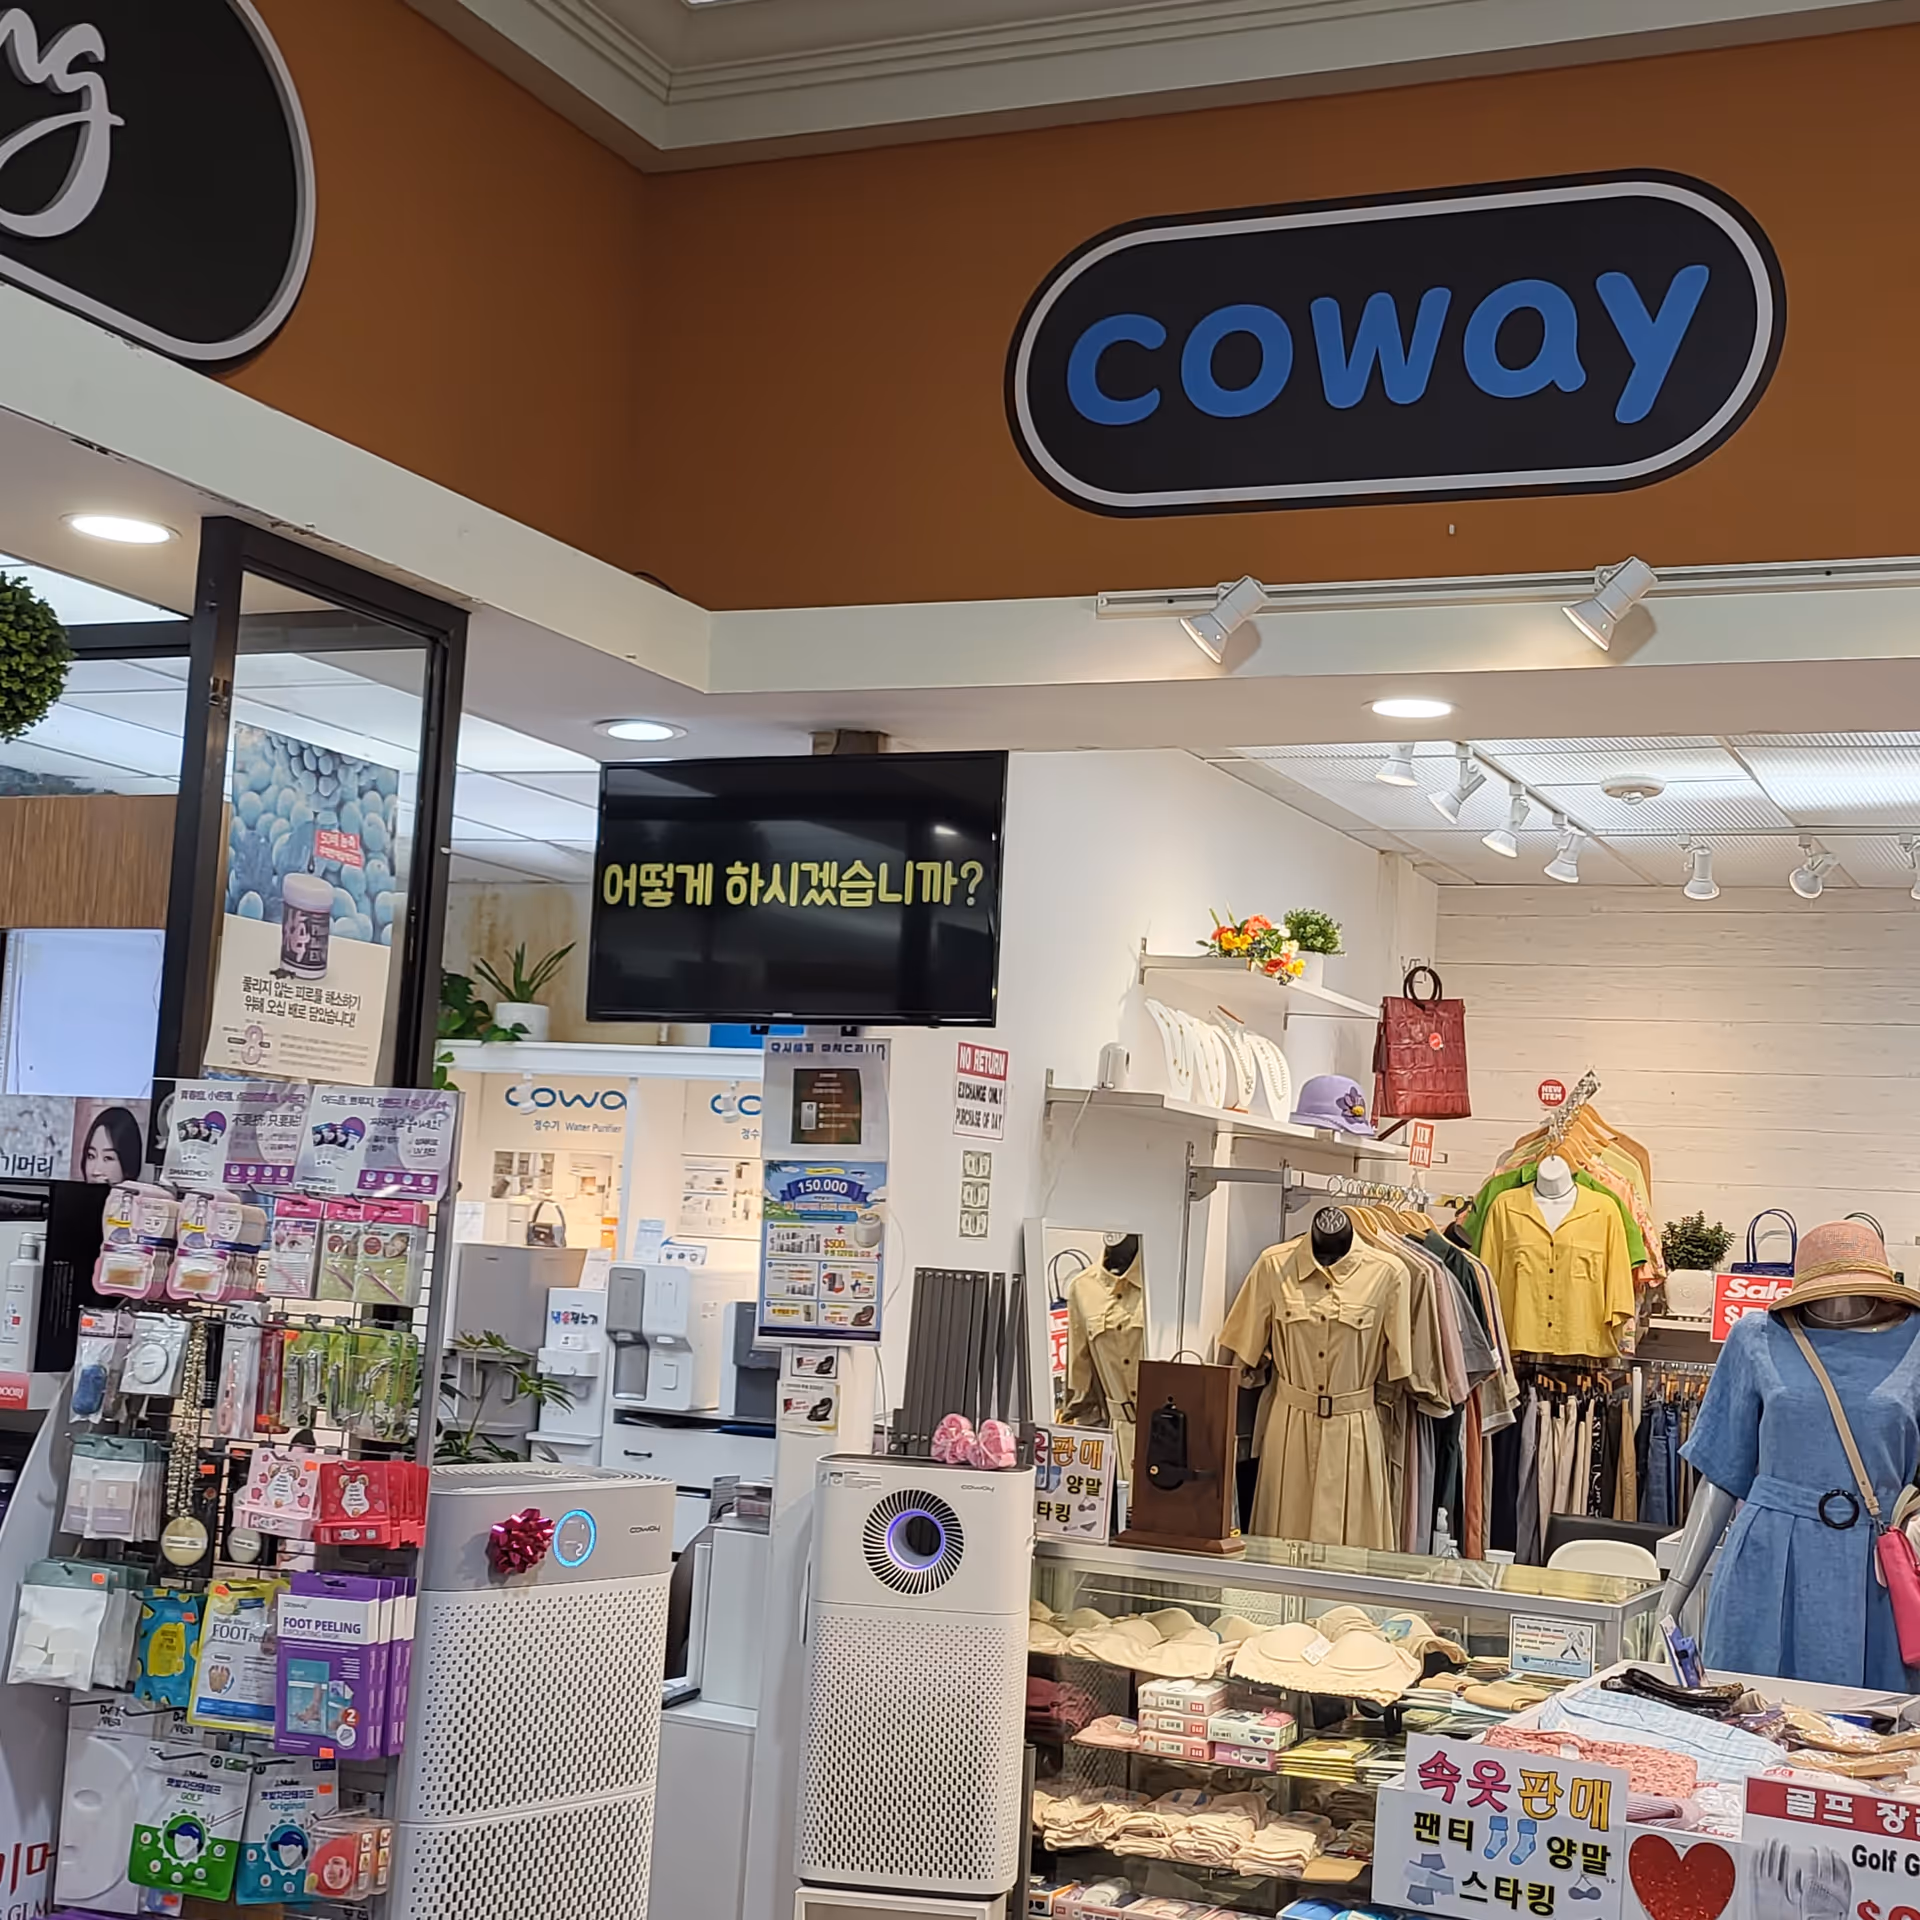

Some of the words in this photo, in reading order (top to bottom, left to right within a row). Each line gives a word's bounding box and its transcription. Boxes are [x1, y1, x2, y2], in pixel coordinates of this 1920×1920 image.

[1067, 264, 1709, 426] coway
[603, 862, 713, 908] 어떻게
[725, 859, 984, 908] 하시겠습니까?
[242, 976, 272, 995] 풀리지
[274, 981, 293, 999] 않는
[244, 995, 265, 1013] 위해
[266, 1000, 286, 1016] 오십
[959, 1045, 972, 1069] NO
[974, 1050, 1005, 1075] RETURN
[957, 1081, 987, 1103] EXCHANGE
[988, 1088, 1003, 1105] ONLY
[1541, 1085, 1563, 1094] NEW
[1541, 1091, 1563, 1101] ITEM
[565, 1122, 590, 1132] Water
[592, 1123, 622, 1134] Purifier
[956, 1107, 982, 1127] PURCHASE
[983, 1113, 990, 1129] OF
[991, 1112, 1003, 1131] DAY
[1724, 1278, 1793, 1300] Sale
[1052, 1436, 1104, 1471] 판매
[1066, 1475, 1102, 1497] 양말
[213, 1623, 250, 1641] FOOT
[283, 1616, 313, 1630] FOOT
[314, 1619, 361, 1635] PEELING
[346, 1709, 357, 1723] 2
[180, 1791, 203, 1801] GOLF
[1418, 1749, 1512, 1813] 속옷
[1517, 1768, 1613, 1832] 판매
[1785, 1787, 1854, 1824] 골프
[1413, 1812, 1475, 1850] 팬티
[1546, 1835, 1612, 1876] 양말
[1852, 1844, 1897, 1873] Golf
[1459, 1870, 1556, 1917] 스타킹
